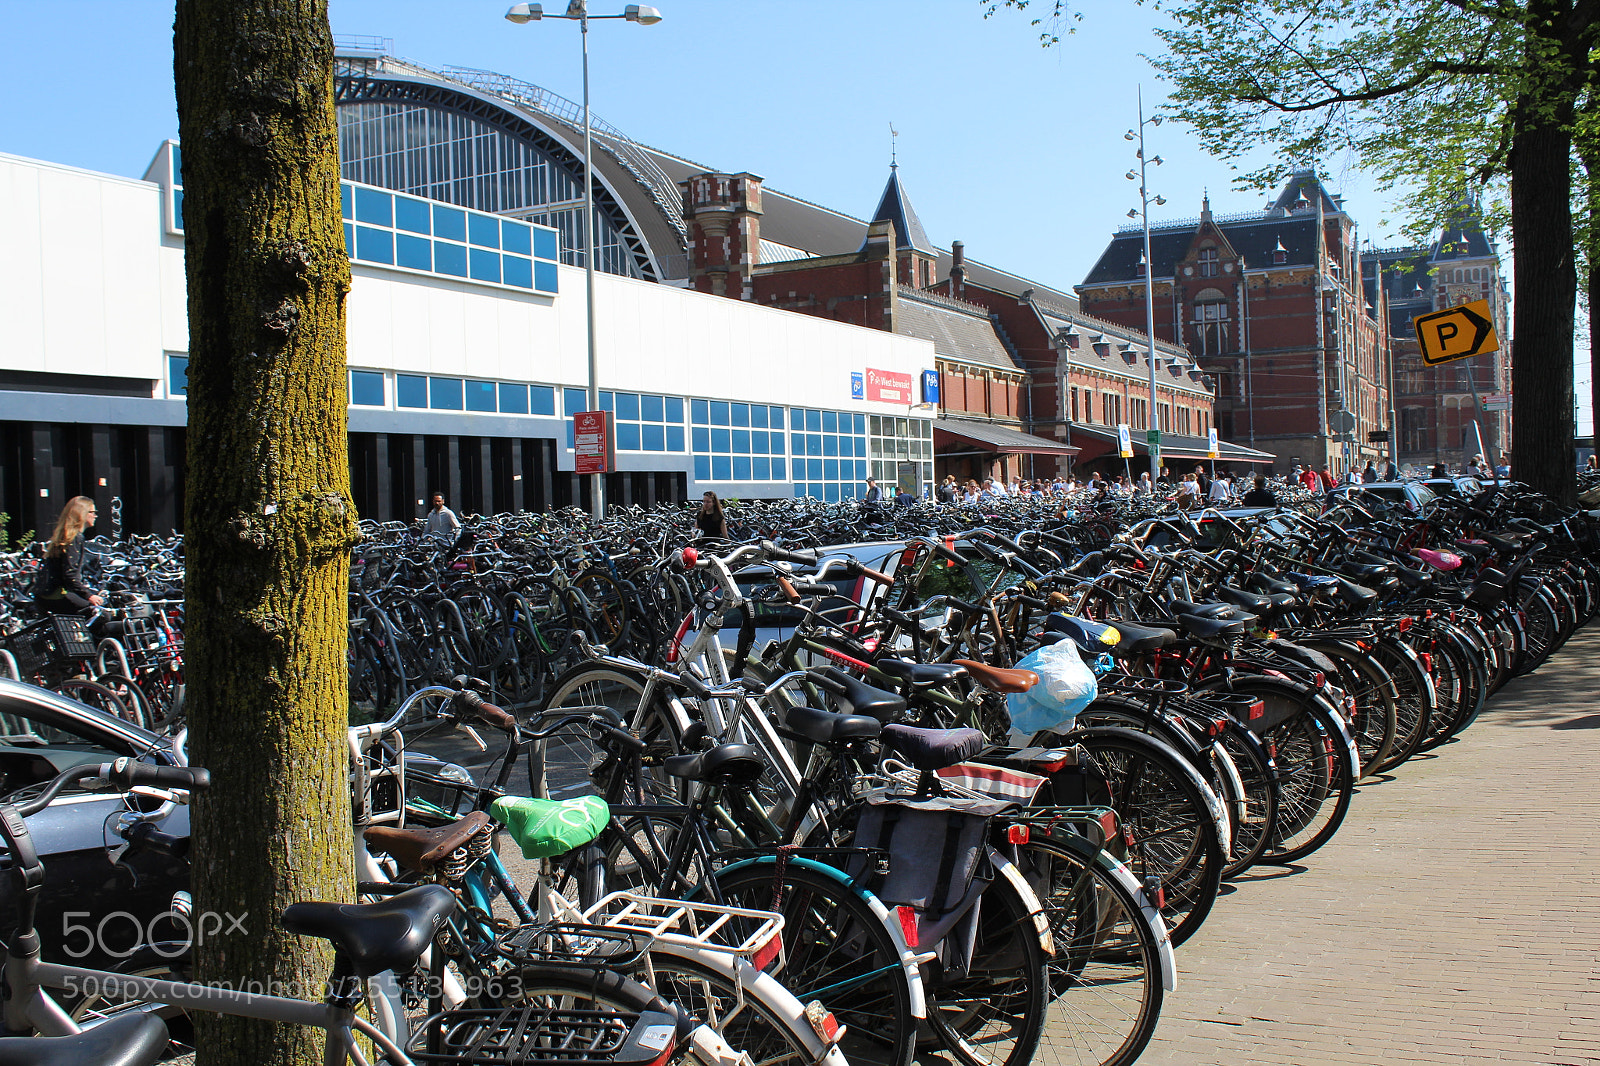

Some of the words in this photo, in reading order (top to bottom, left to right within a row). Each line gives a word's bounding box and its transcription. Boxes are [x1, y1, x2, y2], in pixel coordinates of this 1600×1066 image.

[1436, 322, 1459, 351] P
[881, 376, 893, 387] West
[763, 758, 786, 792] ELLE
